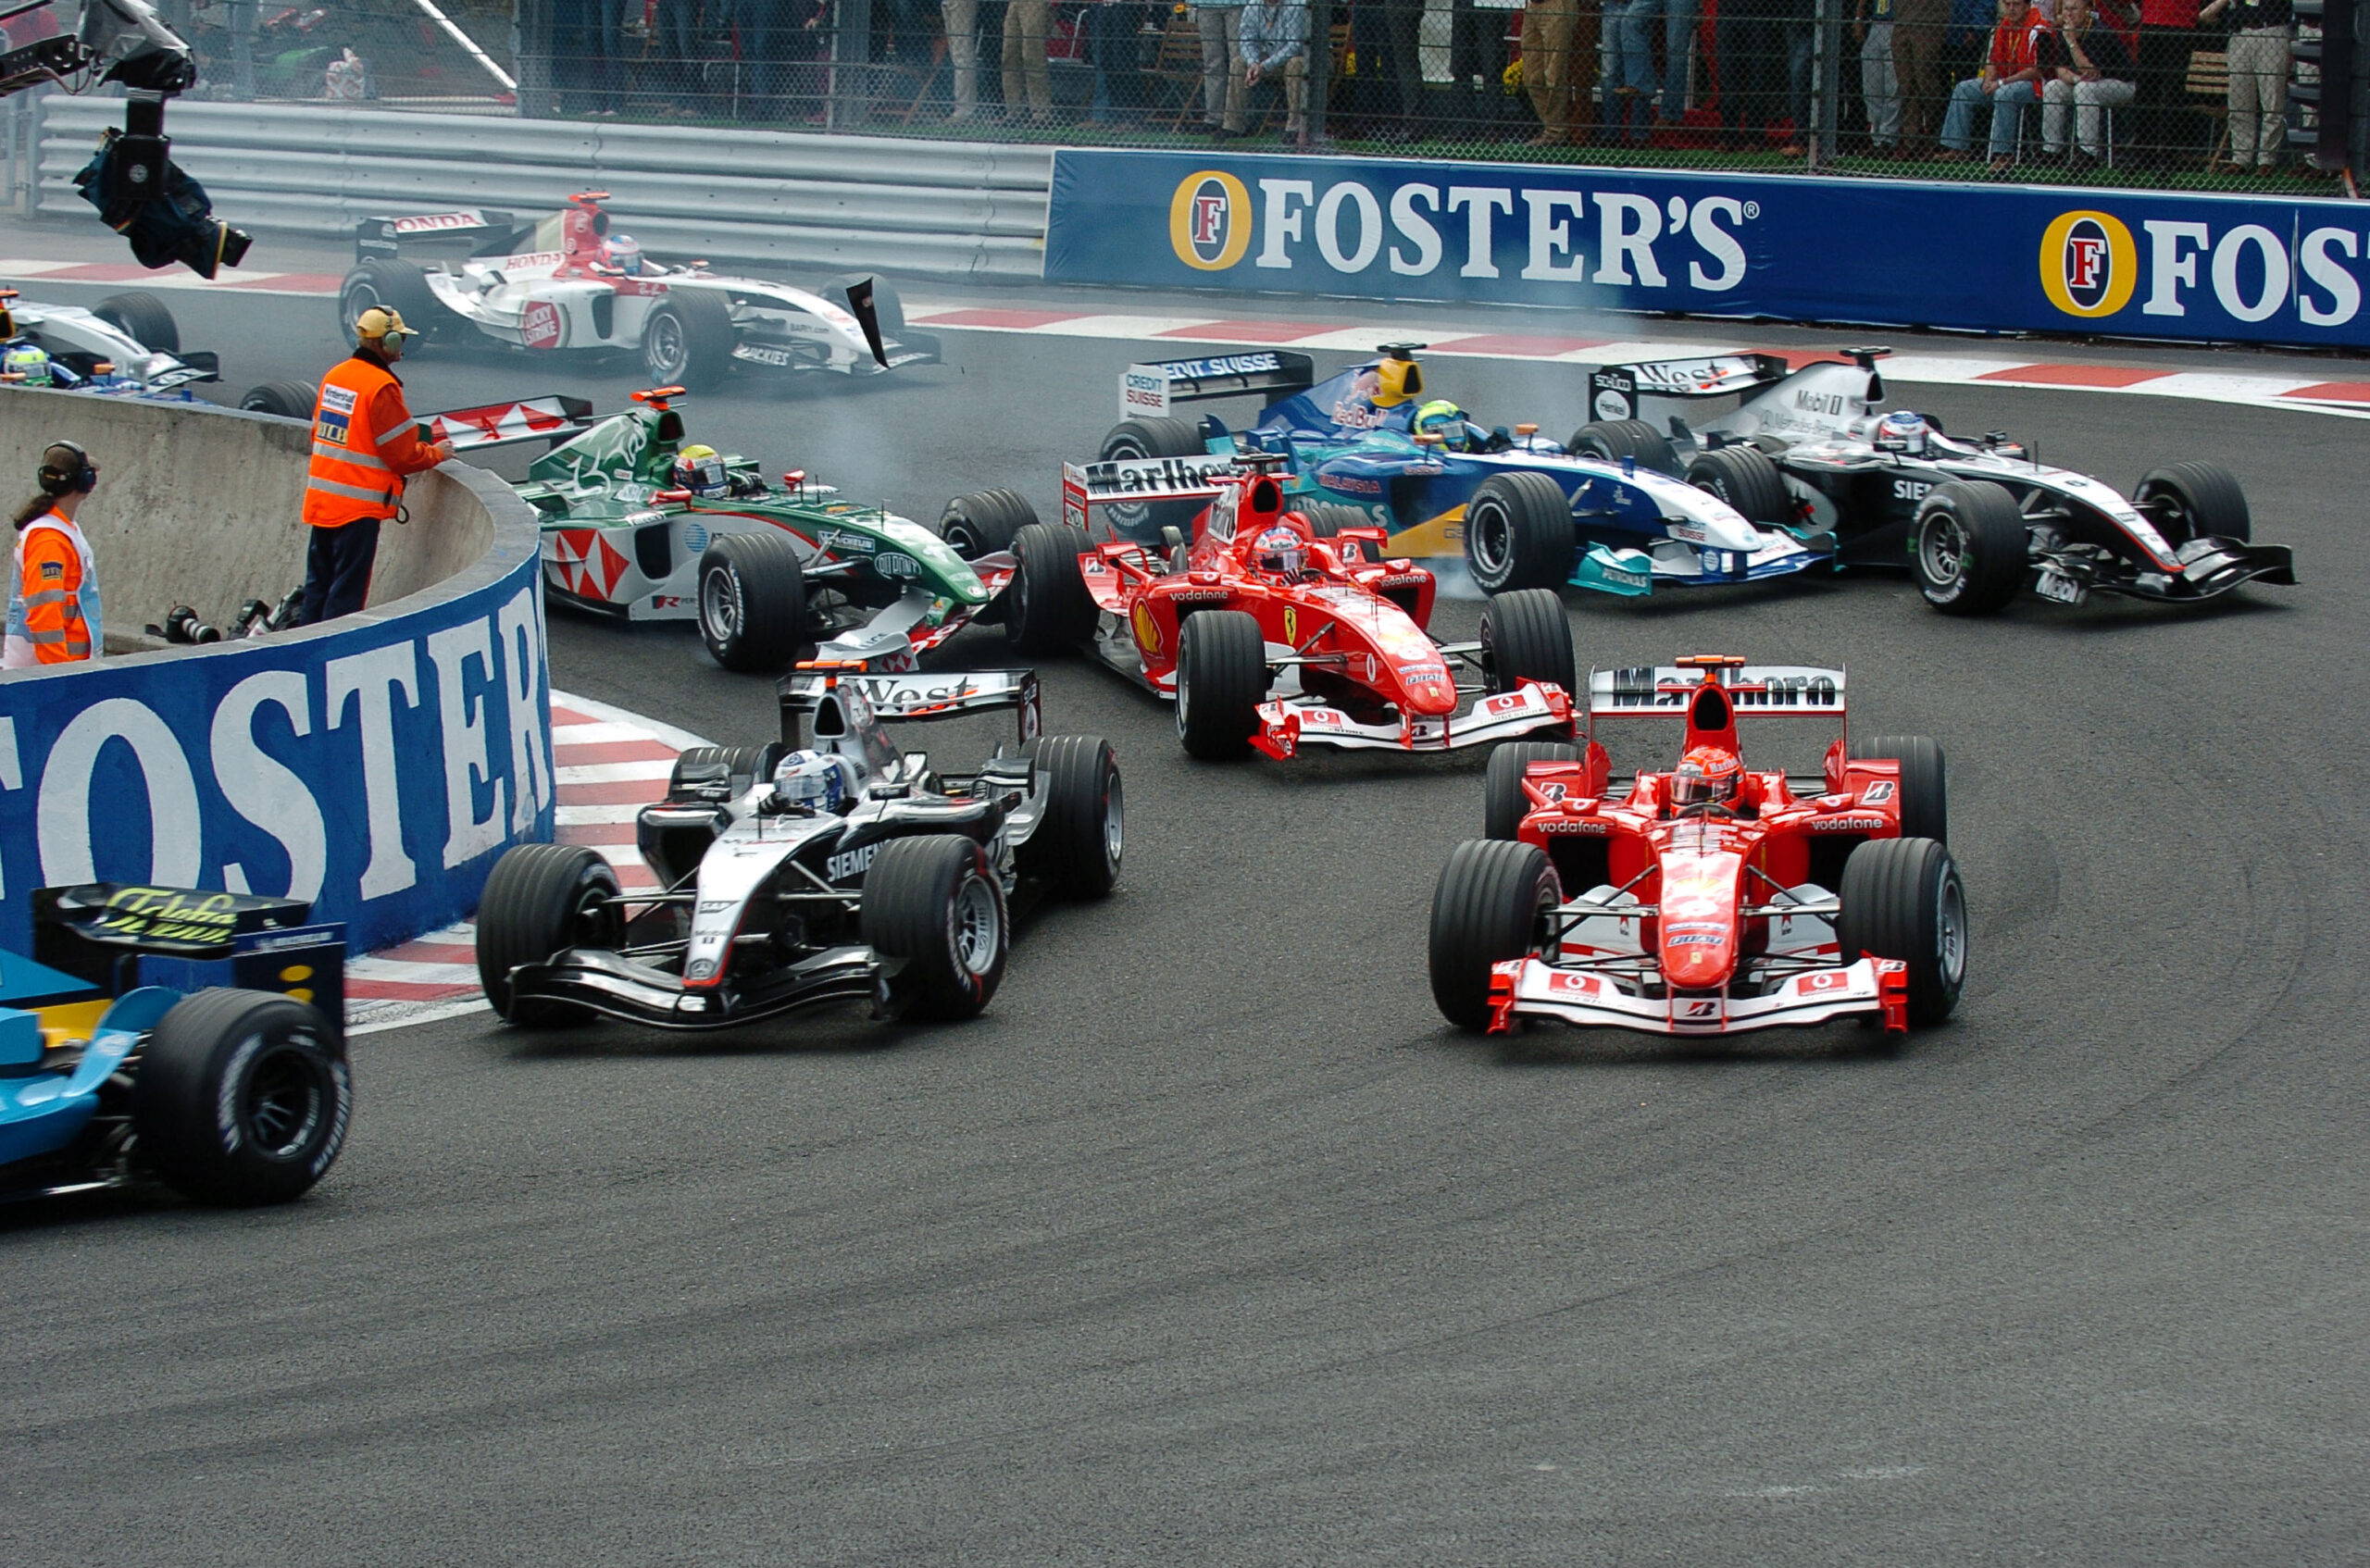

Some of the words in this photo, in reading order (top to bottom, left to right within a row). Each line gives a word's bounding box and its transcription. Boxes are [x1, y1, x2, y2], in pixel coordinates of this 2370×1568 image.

[395, 213, 484, 231] ONDA
[1255, 178, 1748, 292] FOSTER'S
[505, 251, 563, 271] HONDA
[2141, 218, 2370, 327] FOS
[1164, 359, 1204, 380] EDIT
[1209, 353, 1281, 377] SUISSE
[1126, 374, 1164, 392] CREDIT
[1126, 390, 1164, 408] SUISSE
[1793, 389, 1829, 414] Mobil
[1318, 473, 1382, 495] MALAYSIA
[1893, 479, 1935, 501] SIE
[1678, 529, 1706, 541] SUISSE
[1602, 567, 1648, 589] PETRONAS
[1169, 589, 1229, 602] vodafone
[1613, 666, 1837, 707] Maboro
[0, 585, 550, 909] OSTER
[1537, 820, 1607, 834] vodafone
[1811, 815, 1884, 830] vodafone
[827, 839, 892, 882] SIEME
